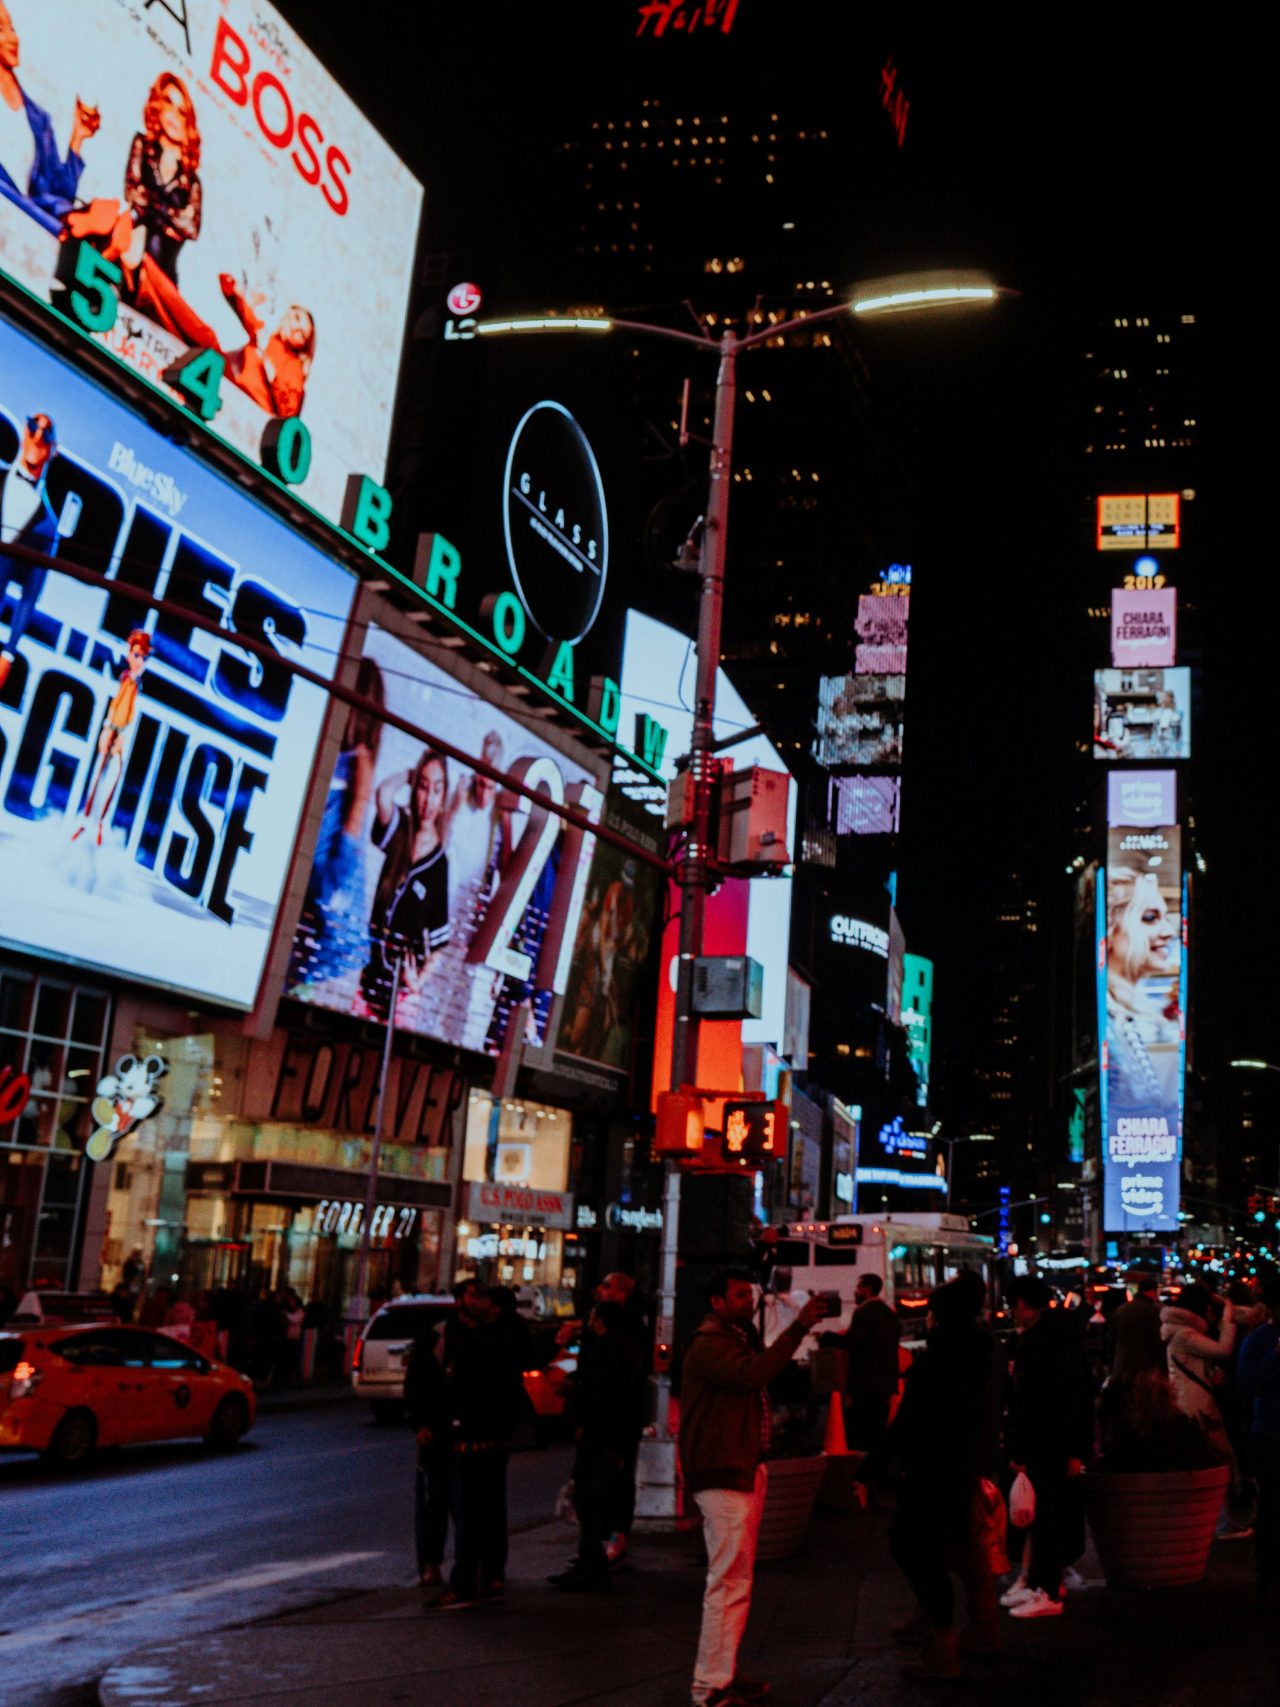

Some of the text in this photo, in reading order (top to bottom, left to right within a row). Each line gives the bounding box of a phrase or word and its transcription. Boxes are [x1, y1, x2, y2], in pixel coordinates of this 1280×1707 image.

[209, 14, 351, 217] BOSS
[519, 472, 598, 561] GLASS
[354, 474, 669, 771] BROADW
[1122, 611, 1164, 625] CHIARA
[1123, 574, 1166, 591] 2019
[487, 757, 604, 995] 21
[271, 1036, 465, 1147] FOREVER
[1117, 1117, 1169, 1136] CHIARA
[315, 1200, 417, 1240] FOREER 21
